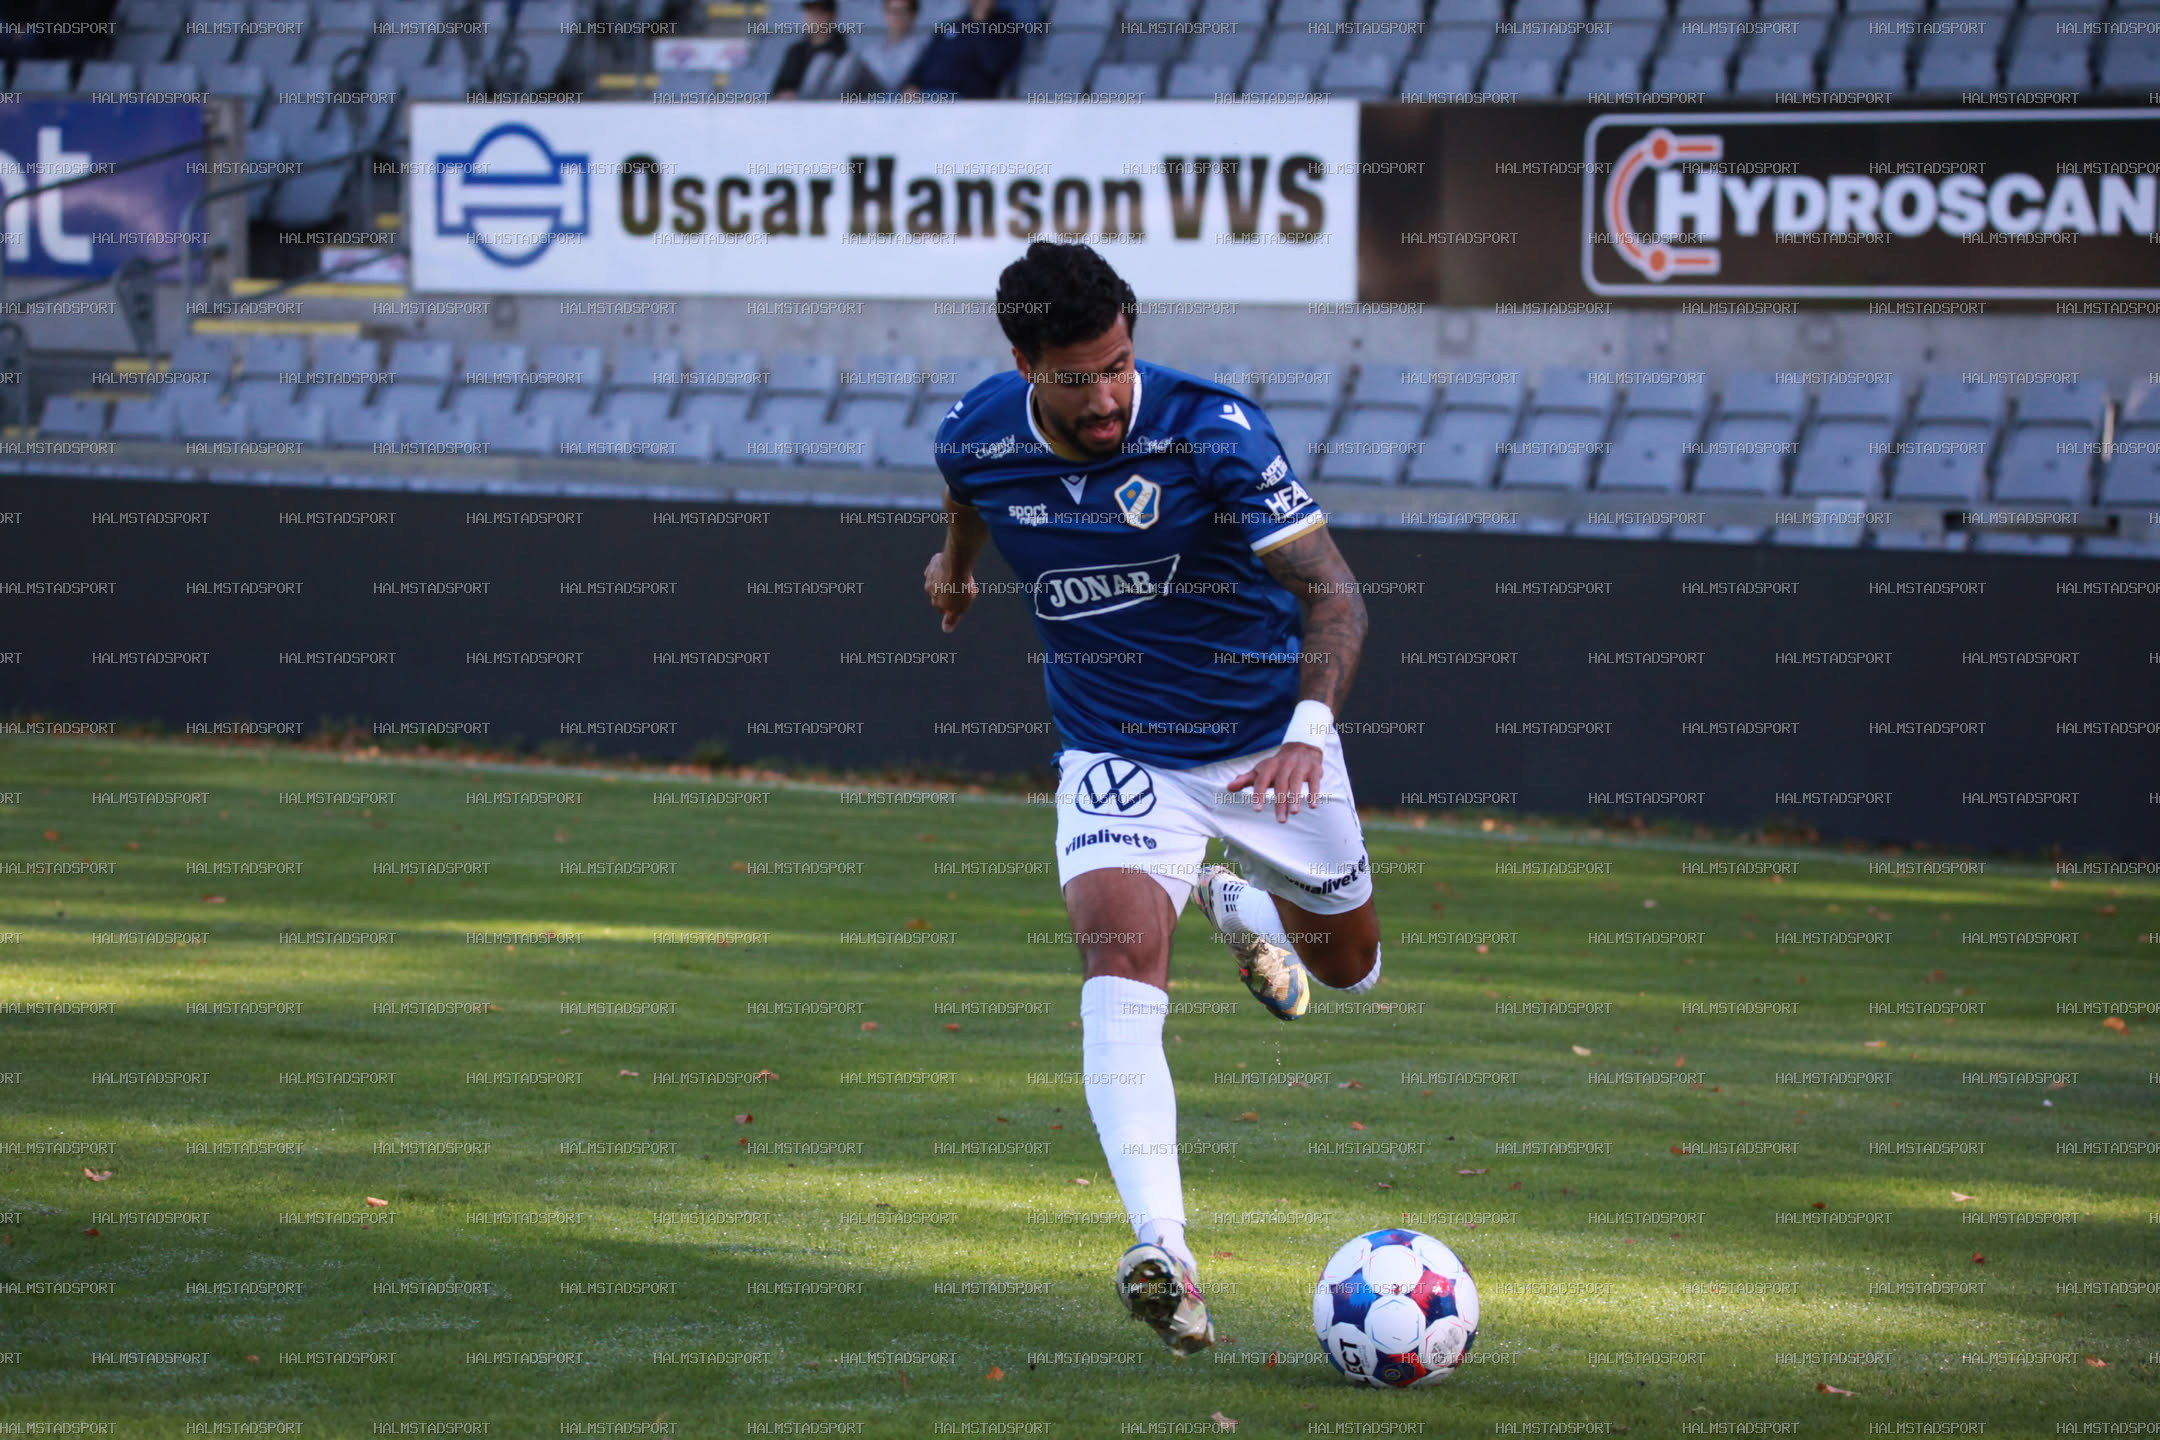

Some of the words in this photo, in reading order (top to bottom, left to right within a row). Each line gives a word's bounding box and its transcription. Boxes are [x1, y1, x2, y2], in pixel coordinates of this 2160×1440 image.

[1163, 154, 1326, 241] VVS
[1008, 503, 1048, 519] sport
[1049, 570, 1154, 608] JONAB
[1065, 828, 1142, 856] villalivet
